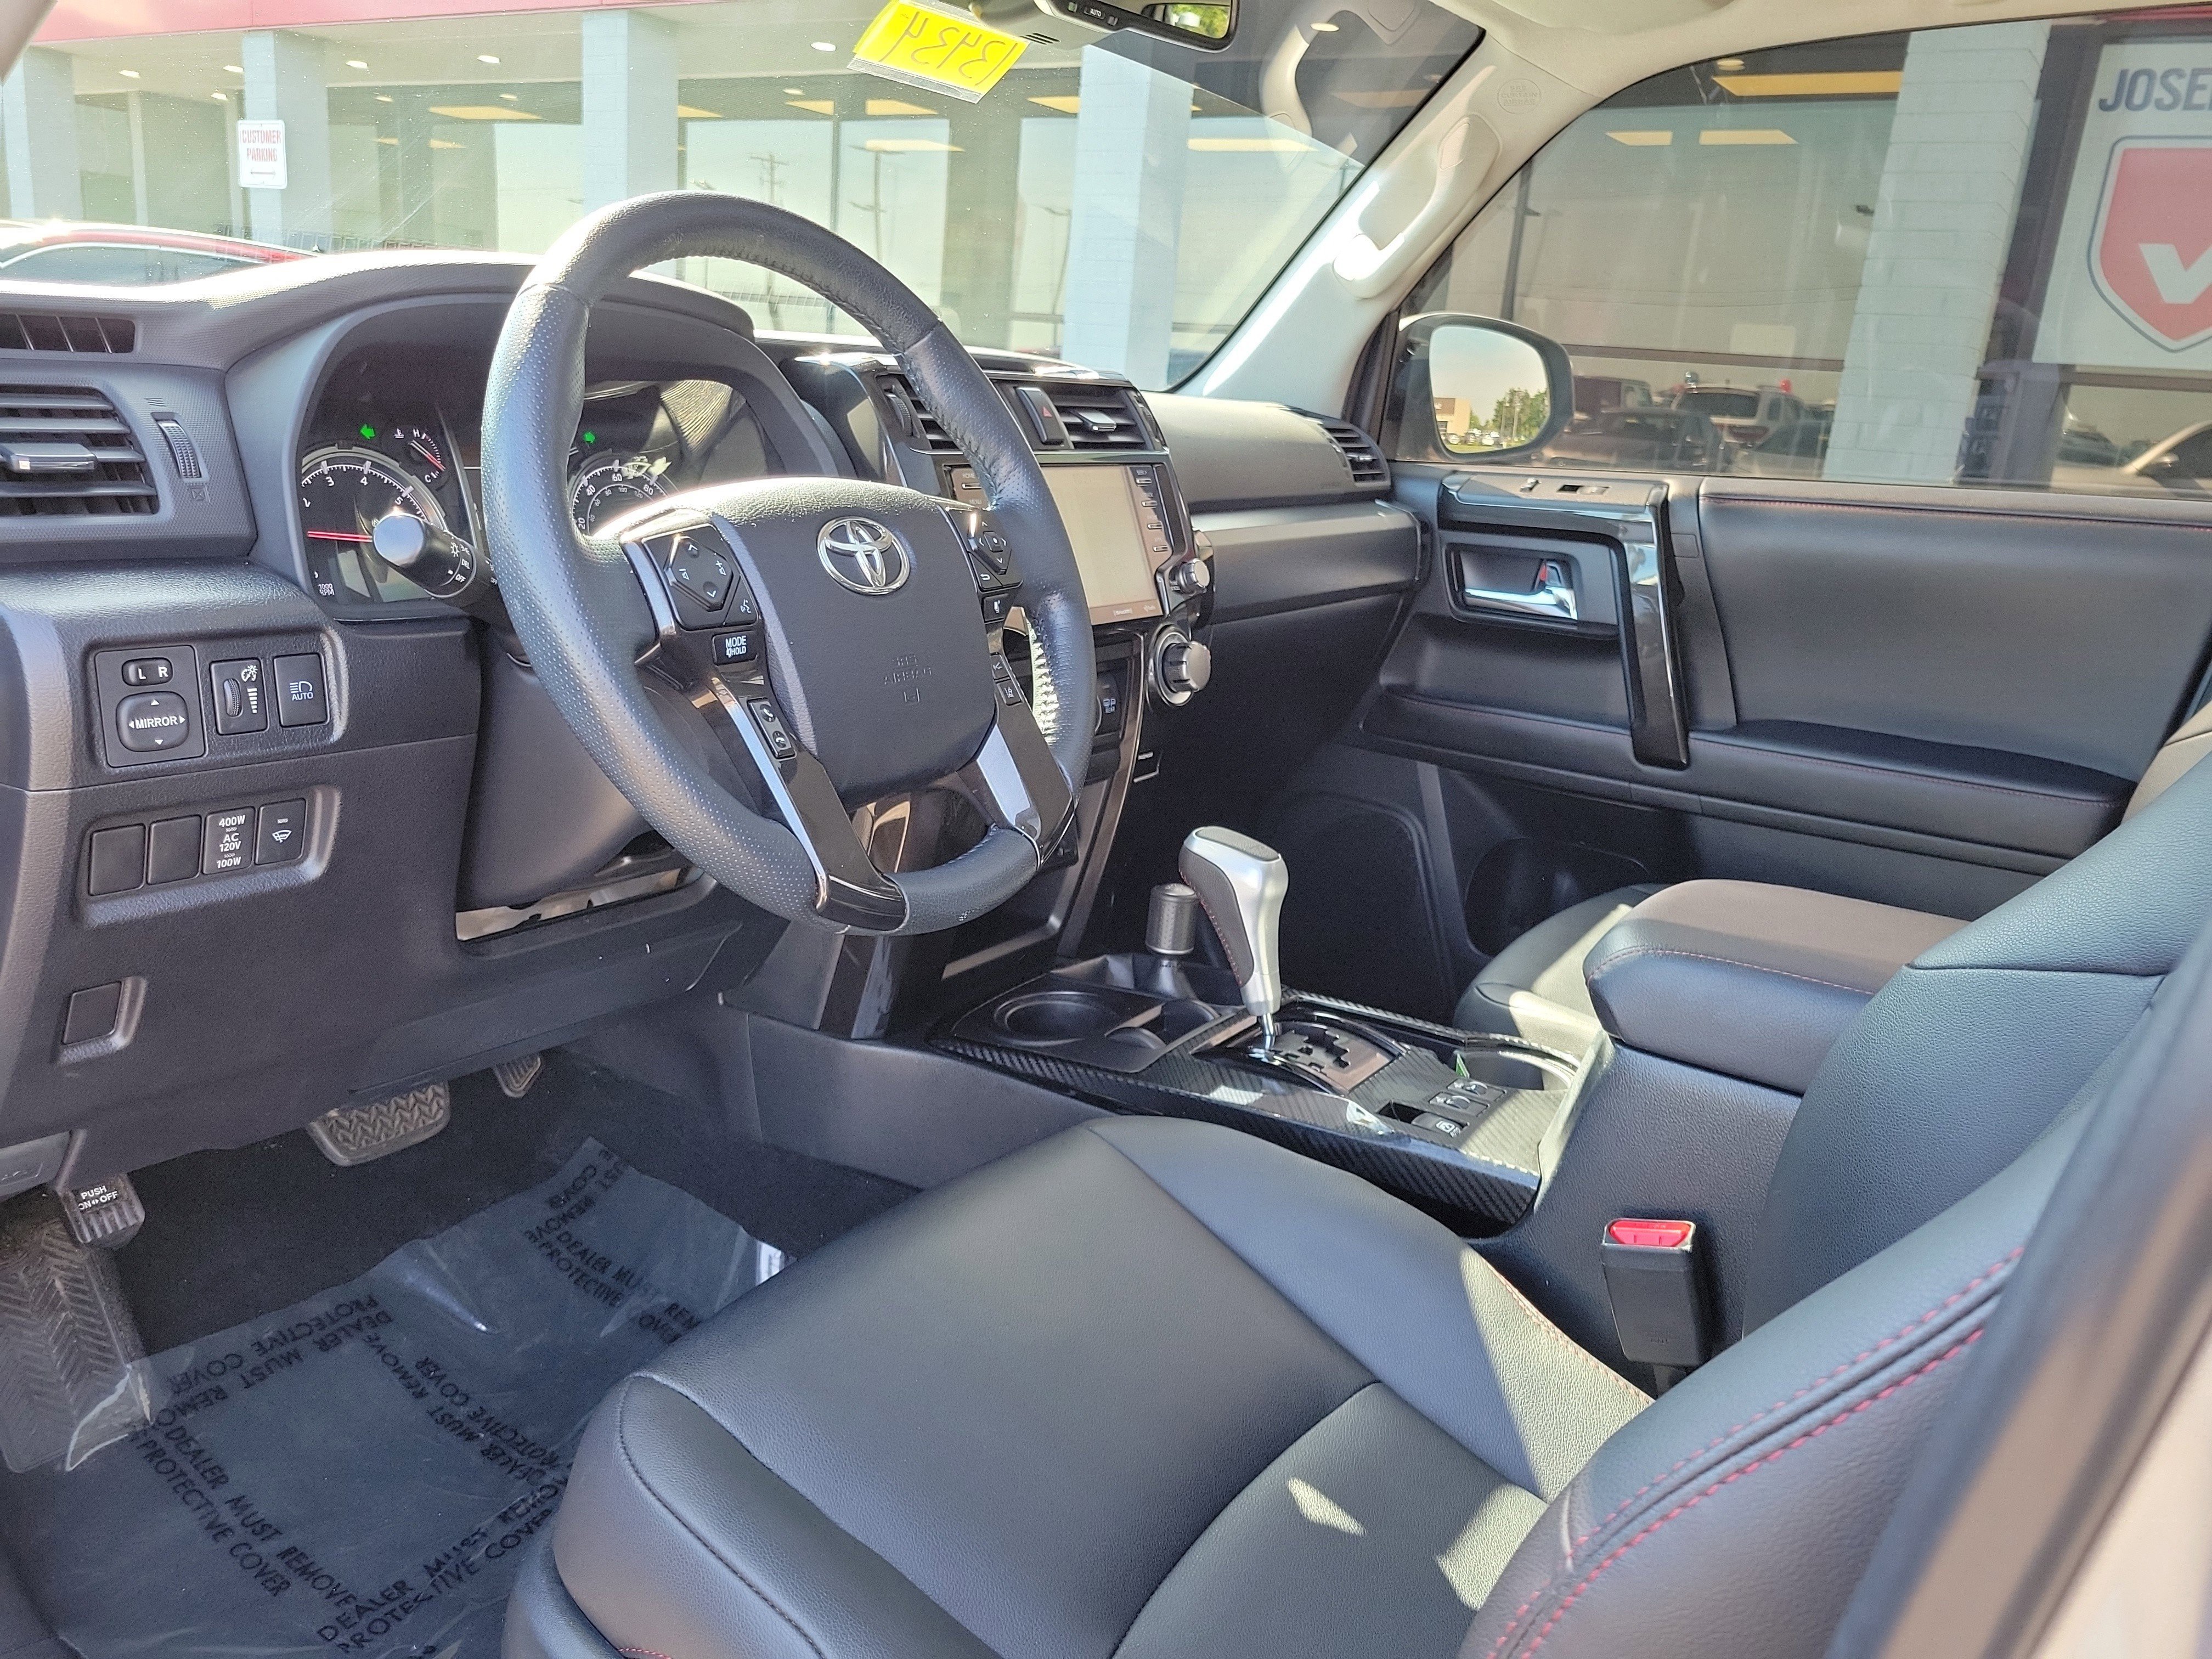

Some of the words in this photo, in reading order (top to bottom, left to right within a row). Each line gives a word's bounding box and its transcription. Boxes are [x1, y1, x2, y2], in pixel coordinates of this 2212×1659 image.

[1090, 8, 1102, 17] AUTO
[2098, 67, 2212, 112] JOSE
[242, 129, 281, 144] CUSTOMER
[246, 148, 278, 162] PARKING
[413, 429, 420, 437] H
[328, 476, 335, 487] 3
[360, 476, 368, 486] 4
[612, 473, 623, 482] 60
[586, 486, 596, 496] 40
[644, 484, 653, 495] 80
[394, 496, 403, 505] 5
[578, 517, 585, 530] 20
[461, 558, 471, 569] DRL
[455, 573, 467, 583] OFF
[725, 635, 747, 648] MODE
[731, 646, 747, 656] HOLD
[138, 668, 146, 680] L
[159, 666, 168, 678] R
[291, 692, 314, 701] AUTO
[135, 715, 178, 729] MIRROR
[218, 815, 246, 827] 400W
[223, 833, 240, 843] AC
[219, 841, 242, 852] 120V
[217, 856, 242, 868] 100W
[81, 1185, 107, 1200] PUSH
[78, 1200, 92, 1210] ON
[99, 1191, 118, 1203] OFF
[555, 1231, 612, 1274] DEALER
[538, 1241, 625, 1308] PROTECTIVE
[250, 1292, 379, 1358] PROTECTIVE
[312, 1310, 394, 1353] DEALER
[240, 1347, 304, 1390] MUST
[363, 1333, 429, 1399] REMOVE
[167, 1353, 244, 1397] COVER
[415, 1356, 470, 1406] COVER
[426, 1405, 480, 1442] MUST
[136, 1439, 236, 1544] PROTECTIVE
[229, 1542, 291, 1598] COVER
[165, 1426, 230, 1490] DEALER
[224, 1495, 284, 1542] MUST
[276, 1545, 357, 1609] REMOVE
[317, 1579, 414, 1642] DEALER
